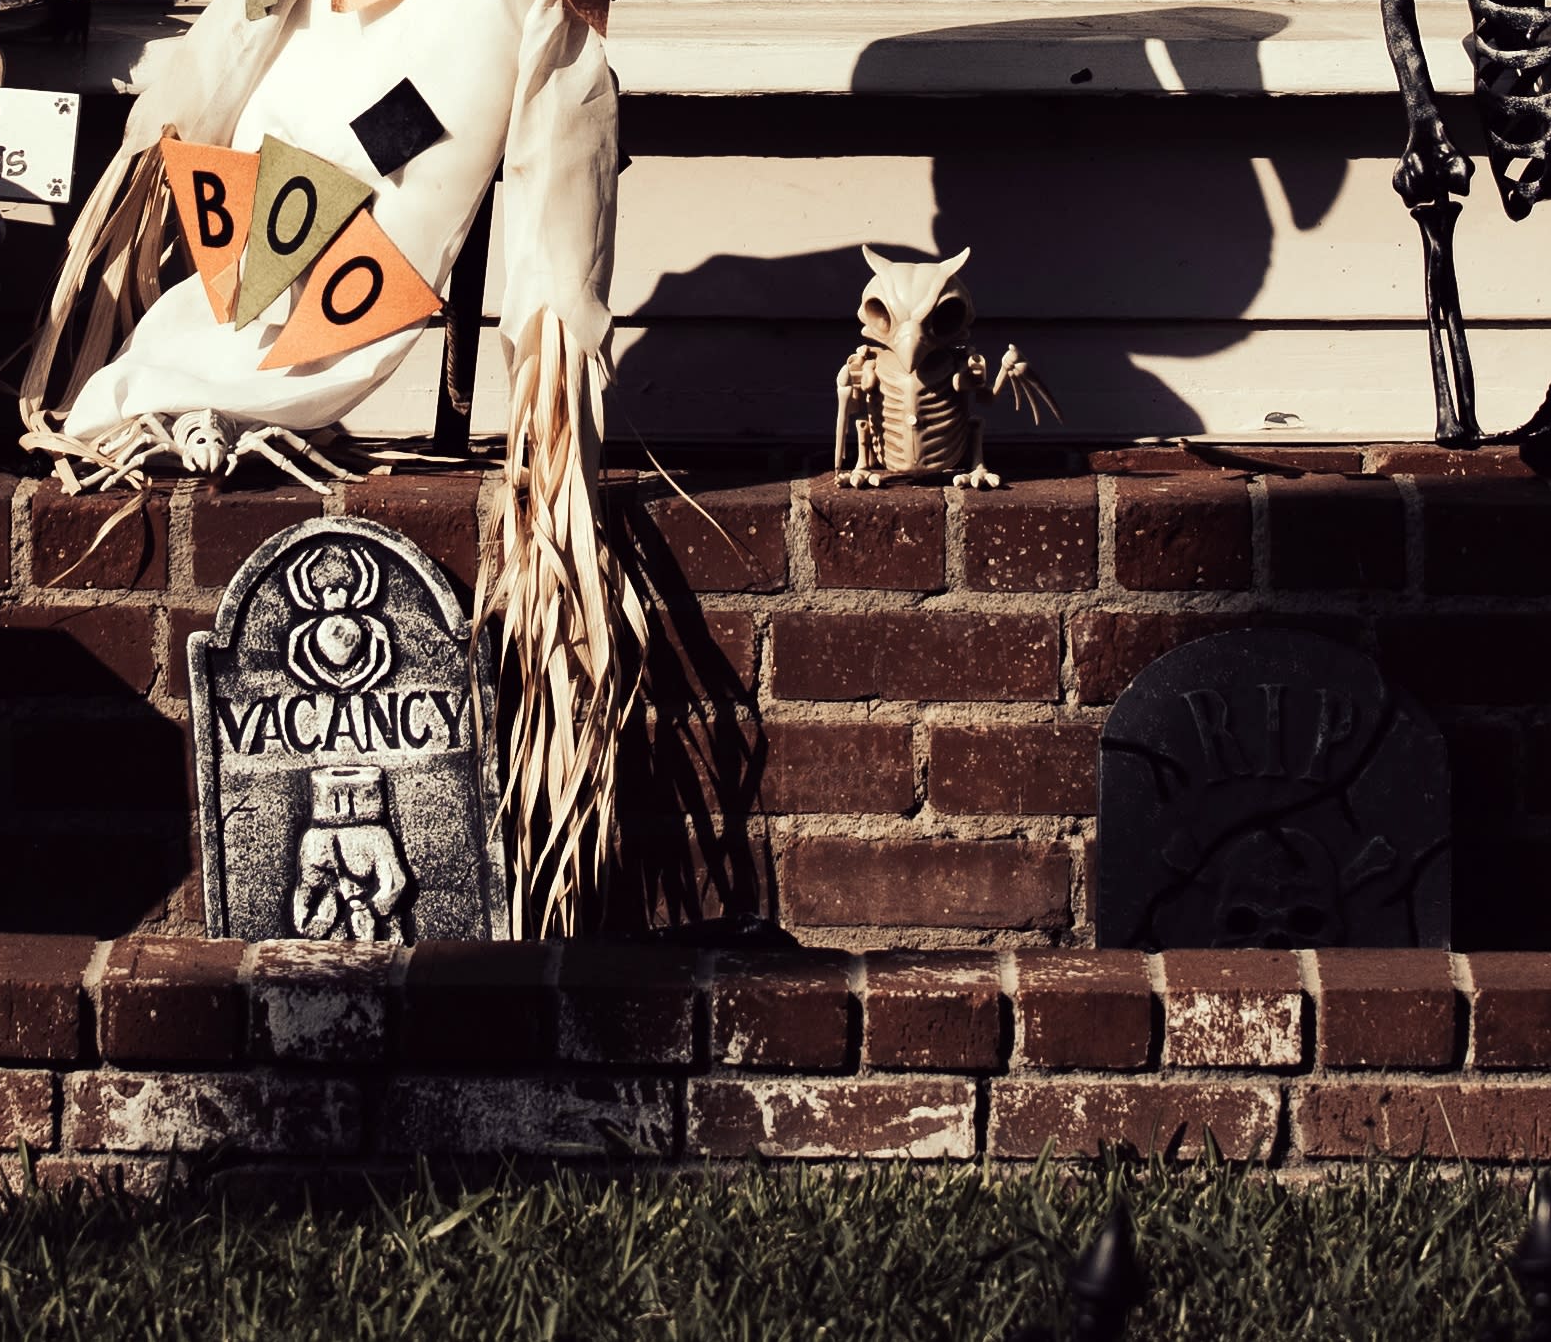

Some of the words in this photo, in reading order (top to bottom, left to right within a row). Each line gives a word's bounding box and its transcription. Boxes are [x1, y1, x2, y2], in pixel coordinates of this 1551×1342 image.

[193, 170, 384, 325] BOO
[217, 691, 471, 755] VACANCY
[1180, 683, 1356, 787] RIP
